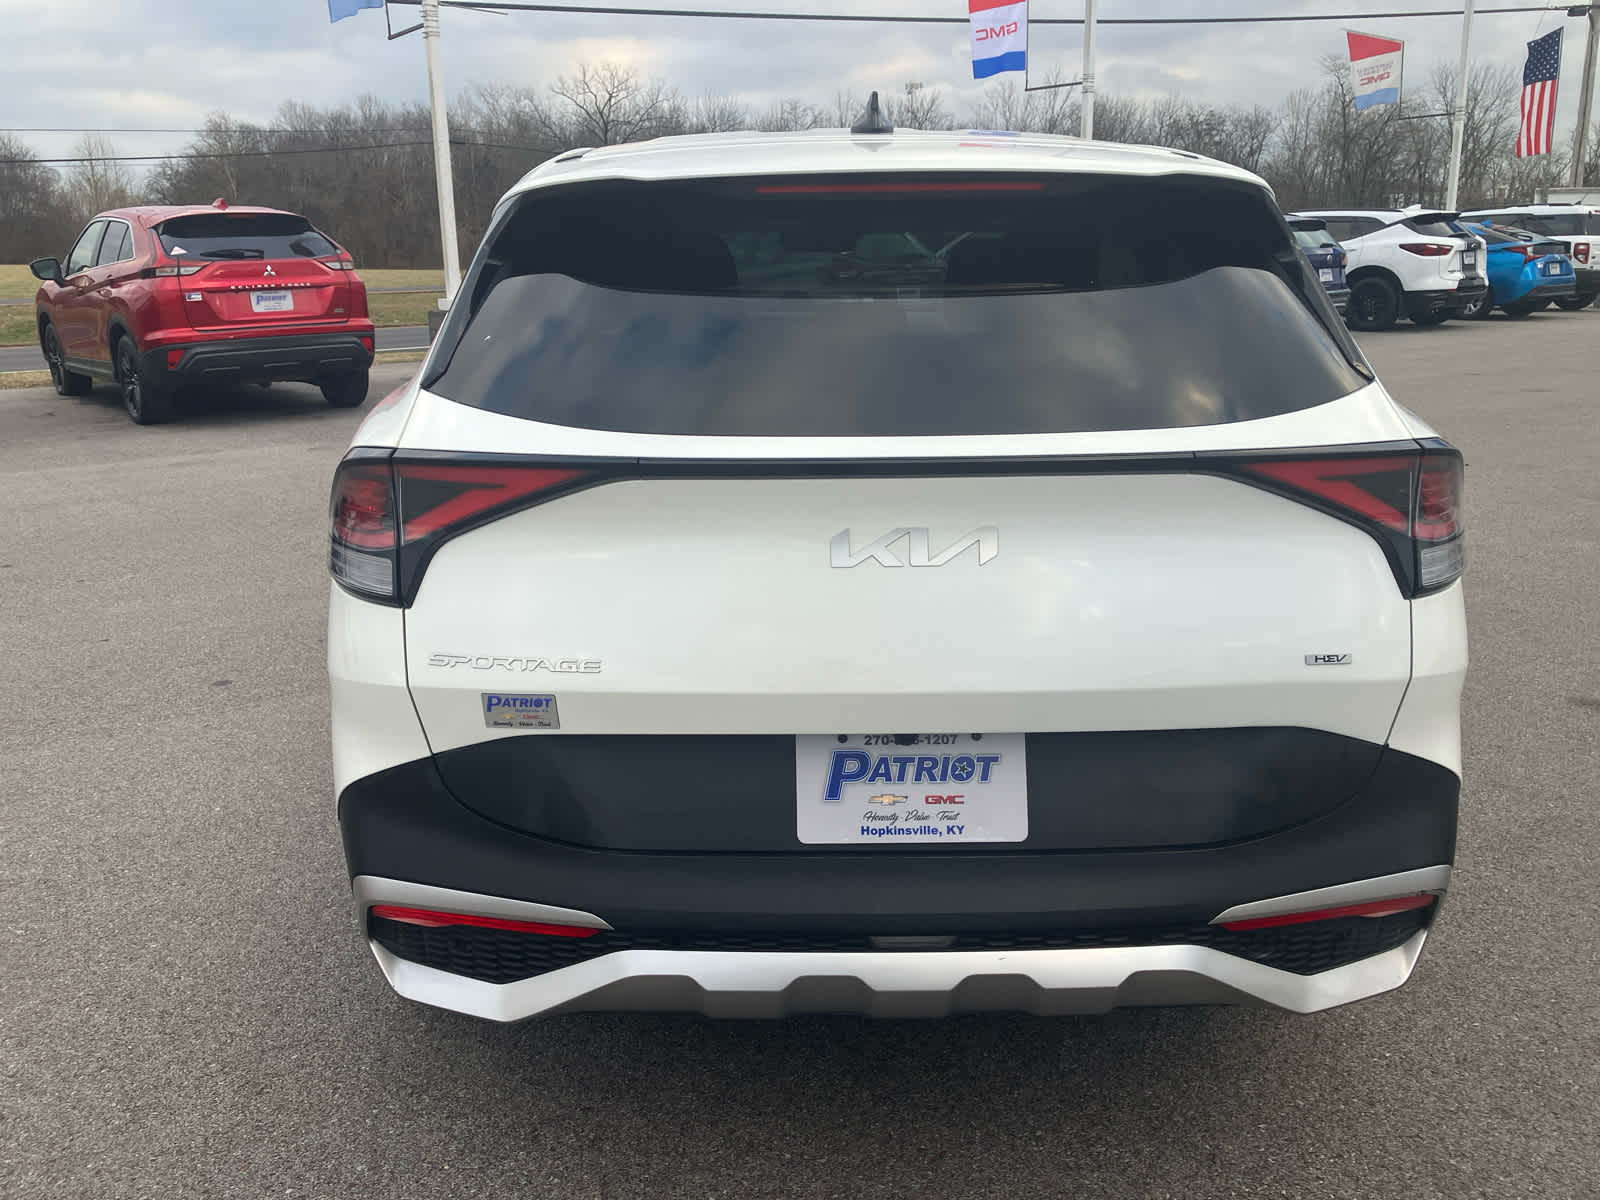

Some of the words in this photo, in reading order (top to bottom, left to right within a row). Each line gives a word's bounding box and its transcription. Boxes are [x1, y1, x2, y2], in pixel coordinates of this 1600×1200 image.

[830, 526, 999, 568] KIA
[427, 653, 602, 674] SPORTAGE
[1314, 654, 1348, 663] HEV
[486, 695, 553, 713] PATRIOT
[863, 733, 959, 746] 270-6-1207
[824, 750, 1000, 801] PATRIOT
[924, 795, 965, 805] GMC
[860, 825, 943, 837] Hopkinsville,
[946, 825, 965, 835] KY
